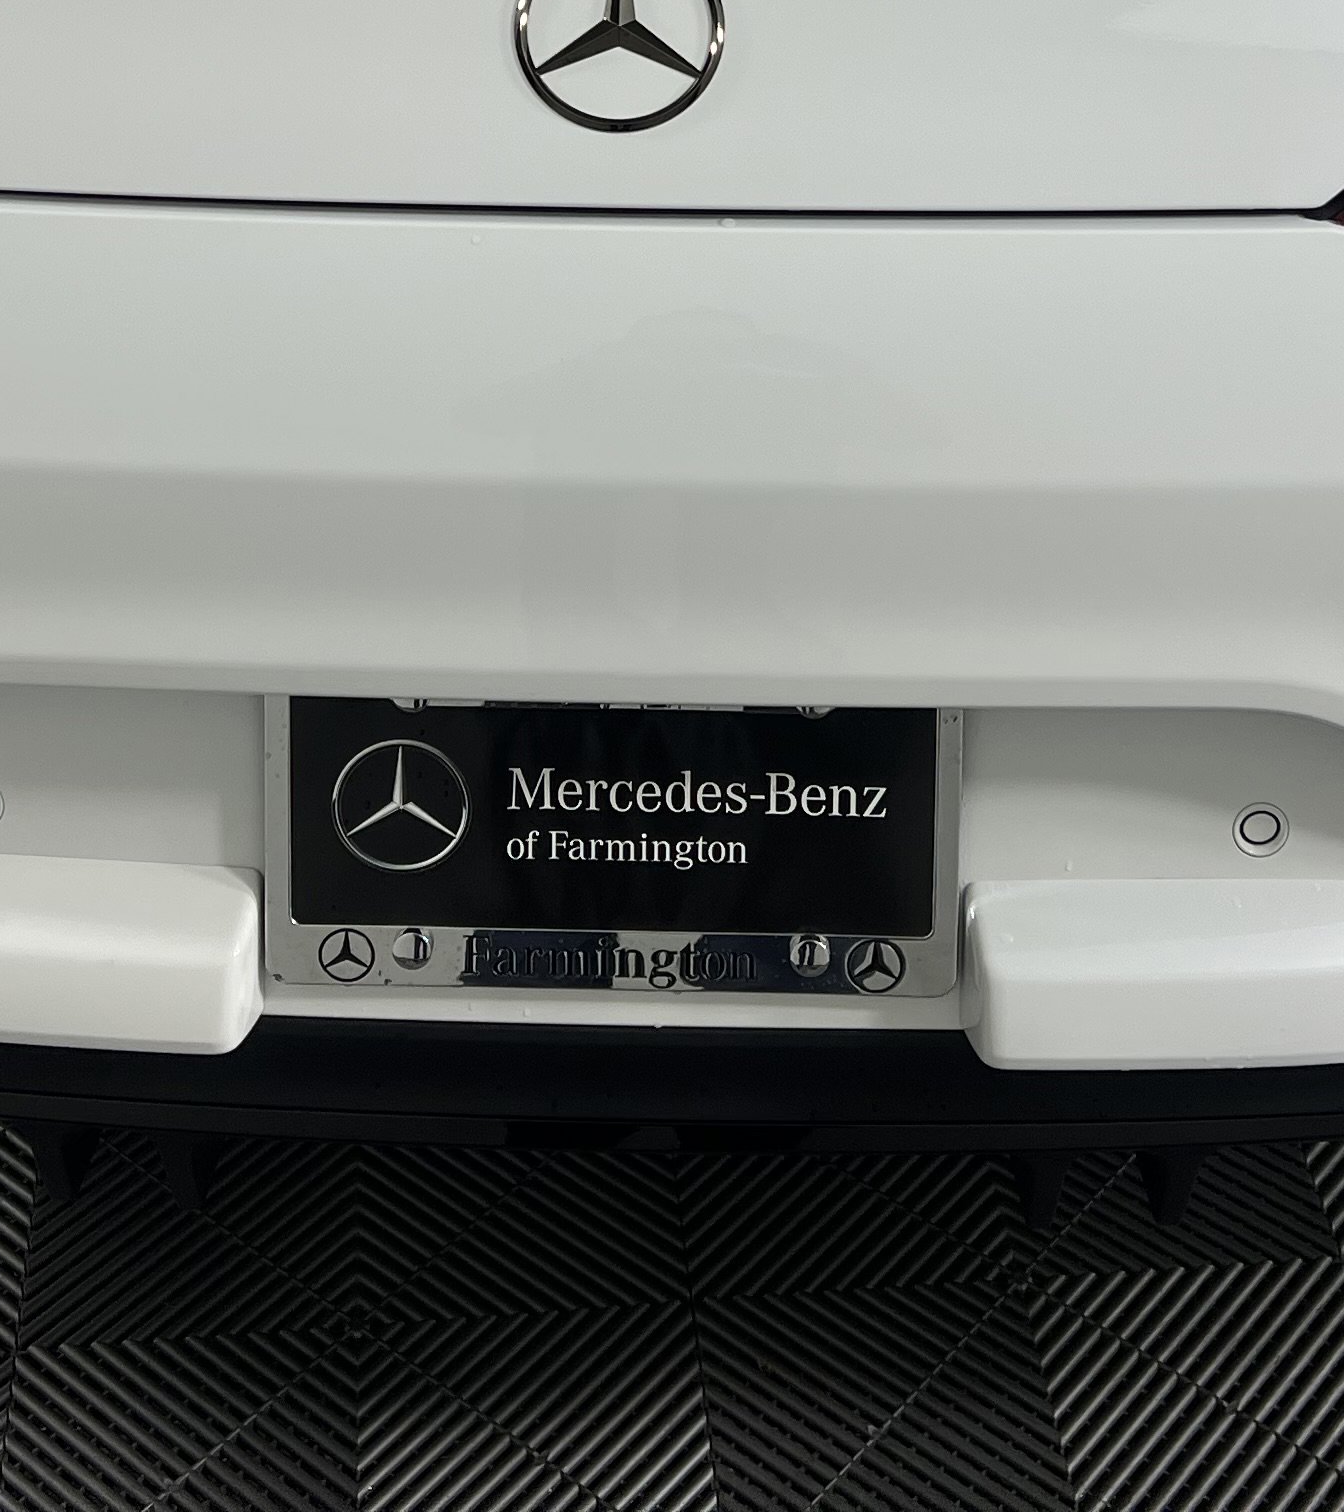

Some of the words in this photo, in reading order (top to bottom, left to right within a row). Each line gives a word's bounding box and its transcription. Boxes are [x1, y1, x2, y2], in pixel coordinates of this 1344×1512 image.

[506, 767, 888, 819] Mercedes-Benz
[506, 830, 540, 861] of
[547, 830, 749, 871] Farmington
[462, 933, 756, 989] Farmington
